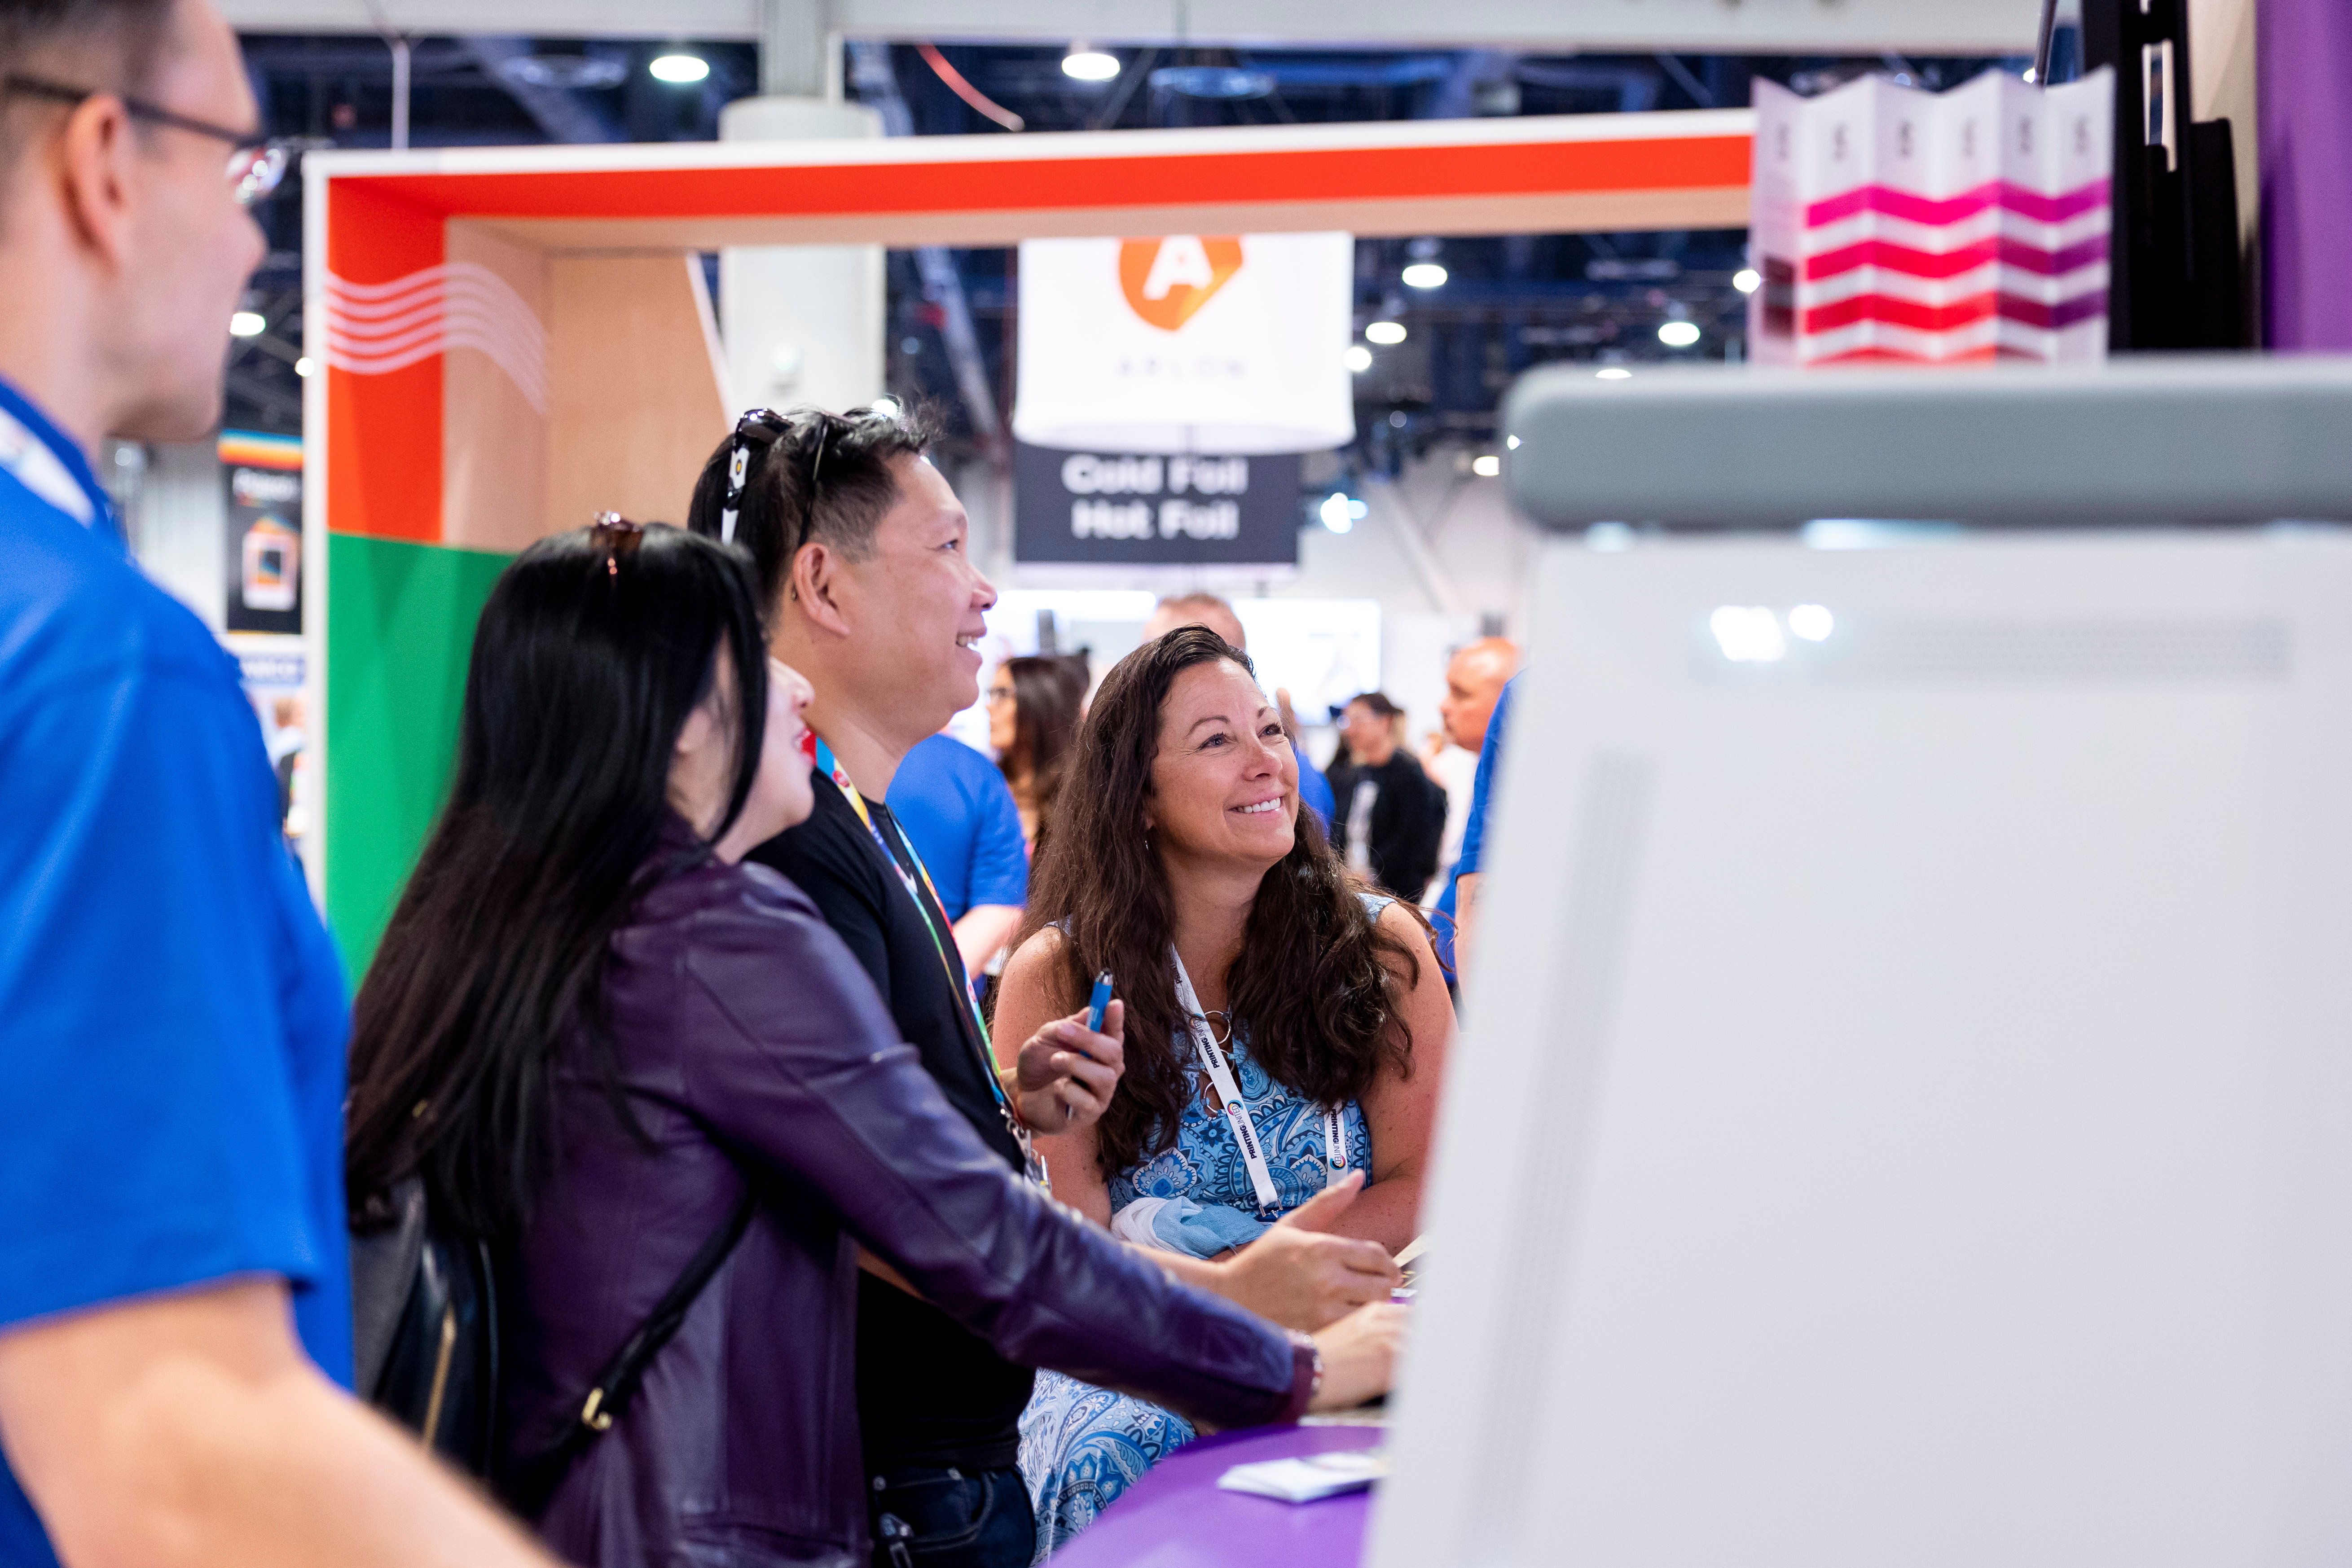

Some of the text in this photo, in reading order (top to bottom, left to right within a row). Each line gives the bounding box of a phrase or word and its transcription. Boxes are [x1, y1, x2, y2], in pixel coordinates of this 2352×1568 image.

[1143, 236, 1213, 300] A
[1115, 355, 1250, 380] ARLON
[1169, 453, 1249, 494] Foil
[1070, 498, 1240, 539] Hot Foil
